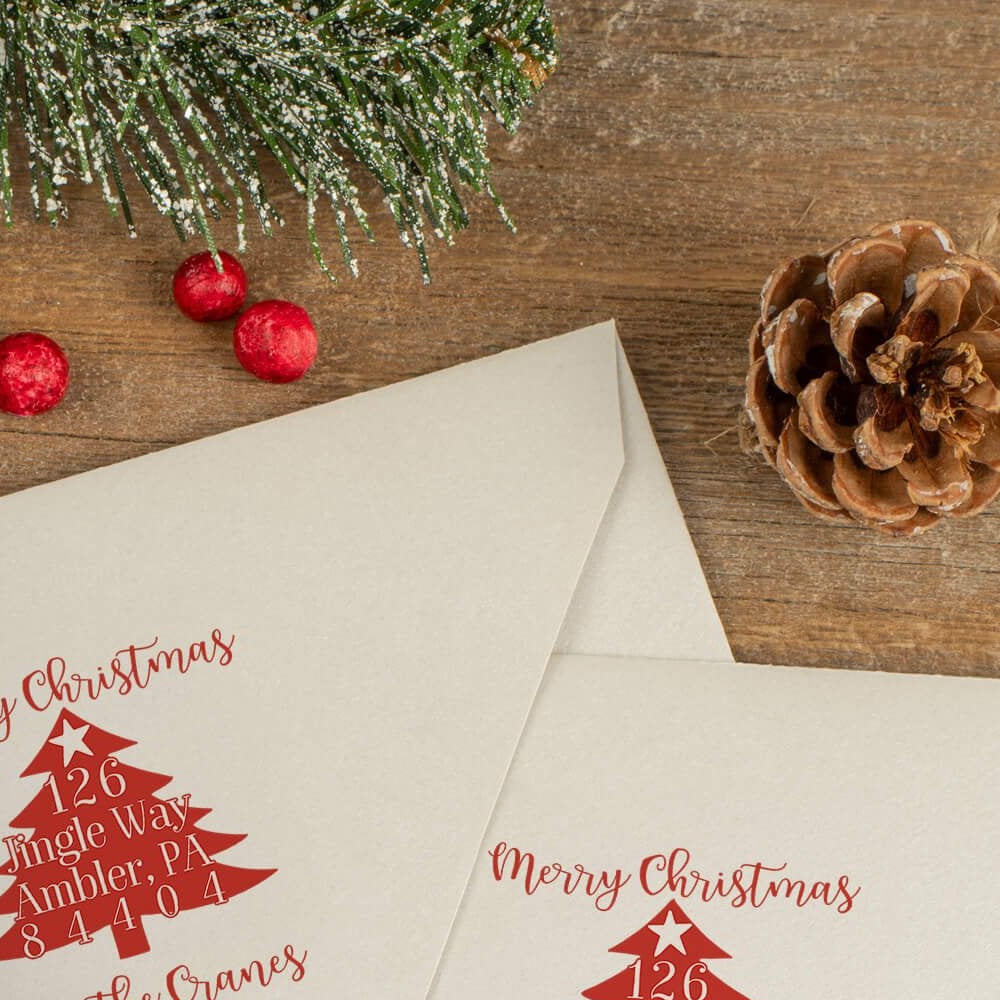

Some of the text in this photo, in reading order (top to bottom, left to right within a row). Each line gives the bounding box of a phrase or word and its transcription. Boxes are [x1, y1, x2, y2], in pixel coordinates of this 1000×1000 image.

[22, 628, 236, 712] Christmas
[41, 756, 128, 816] 126
[2, 794, 192, 873] Jingle Way
[14, 833, 216, 921] Ambler, PA
[488, 841, 862, 914] Merry Christmas
